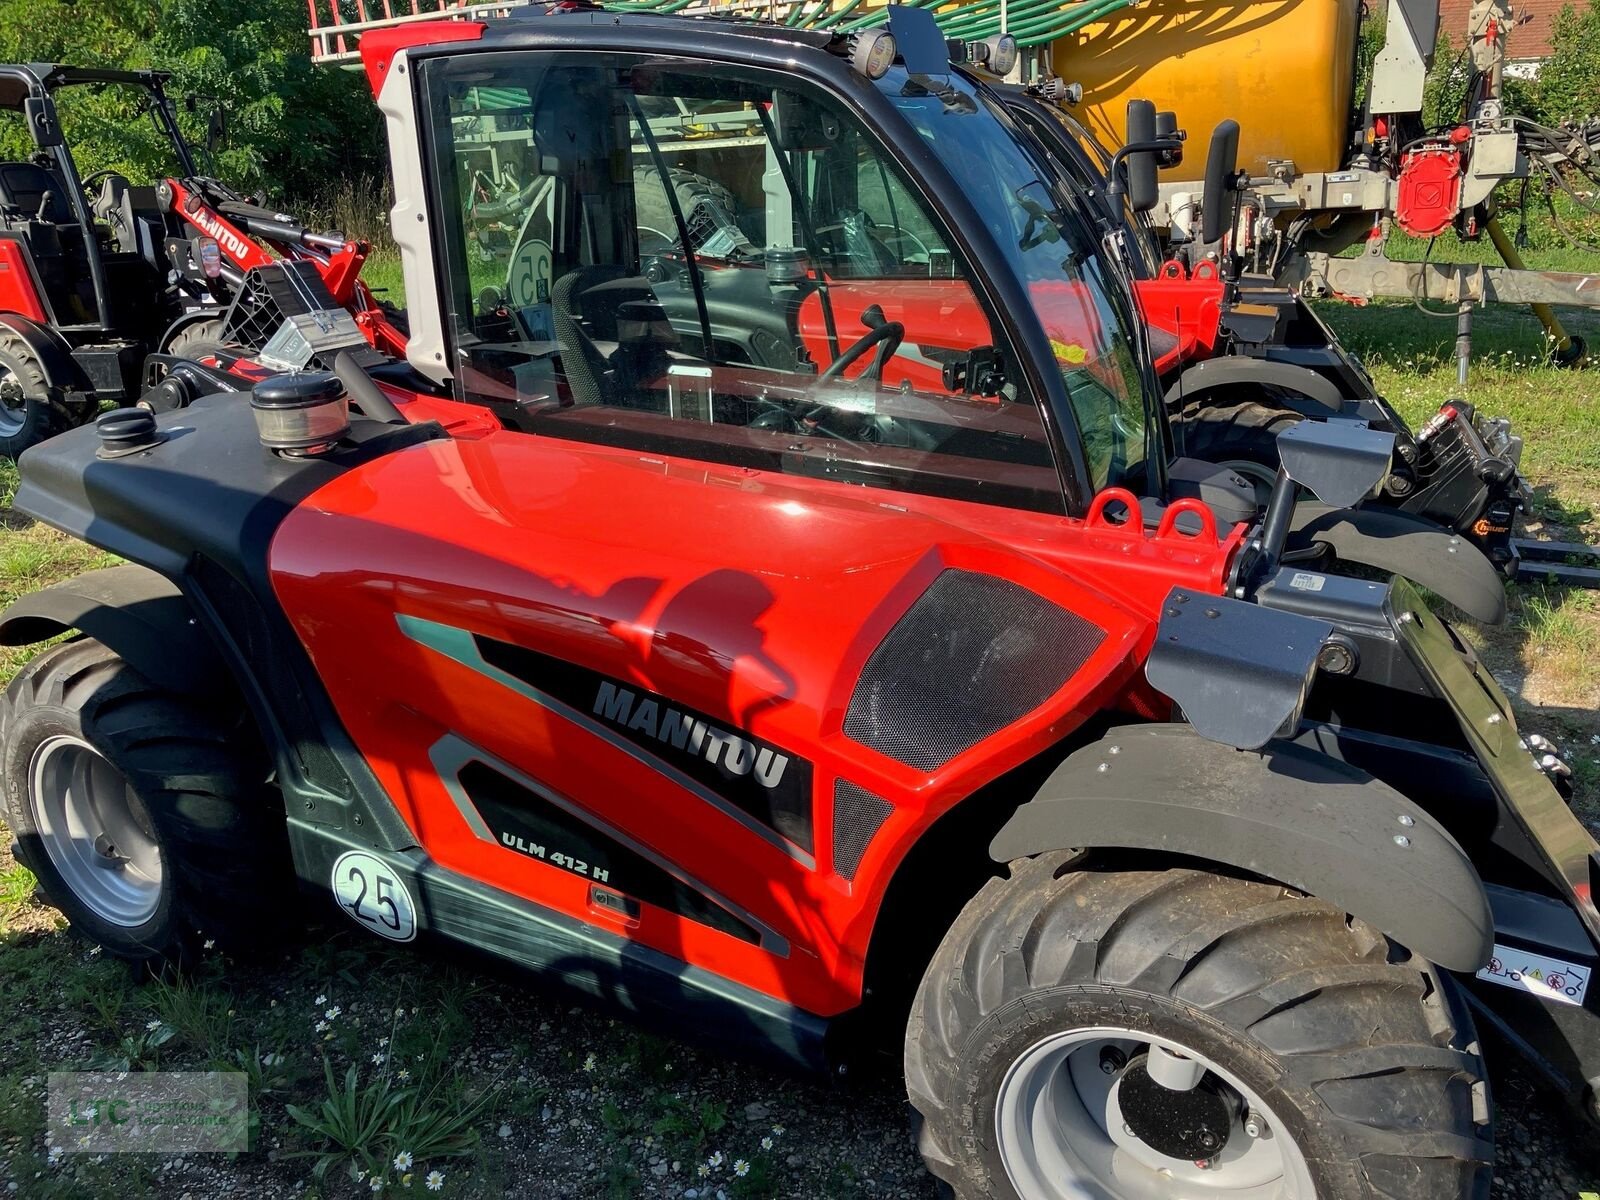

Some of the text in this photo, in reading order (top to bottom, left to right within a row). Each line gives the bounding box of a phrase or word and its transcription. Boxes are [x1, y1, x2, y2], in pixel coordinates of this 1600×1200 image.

[593, 680, 789, 788] MANITOU
[502, 831, 609, 883] ULM 412 H
[343, 867, 400, 931] 25
